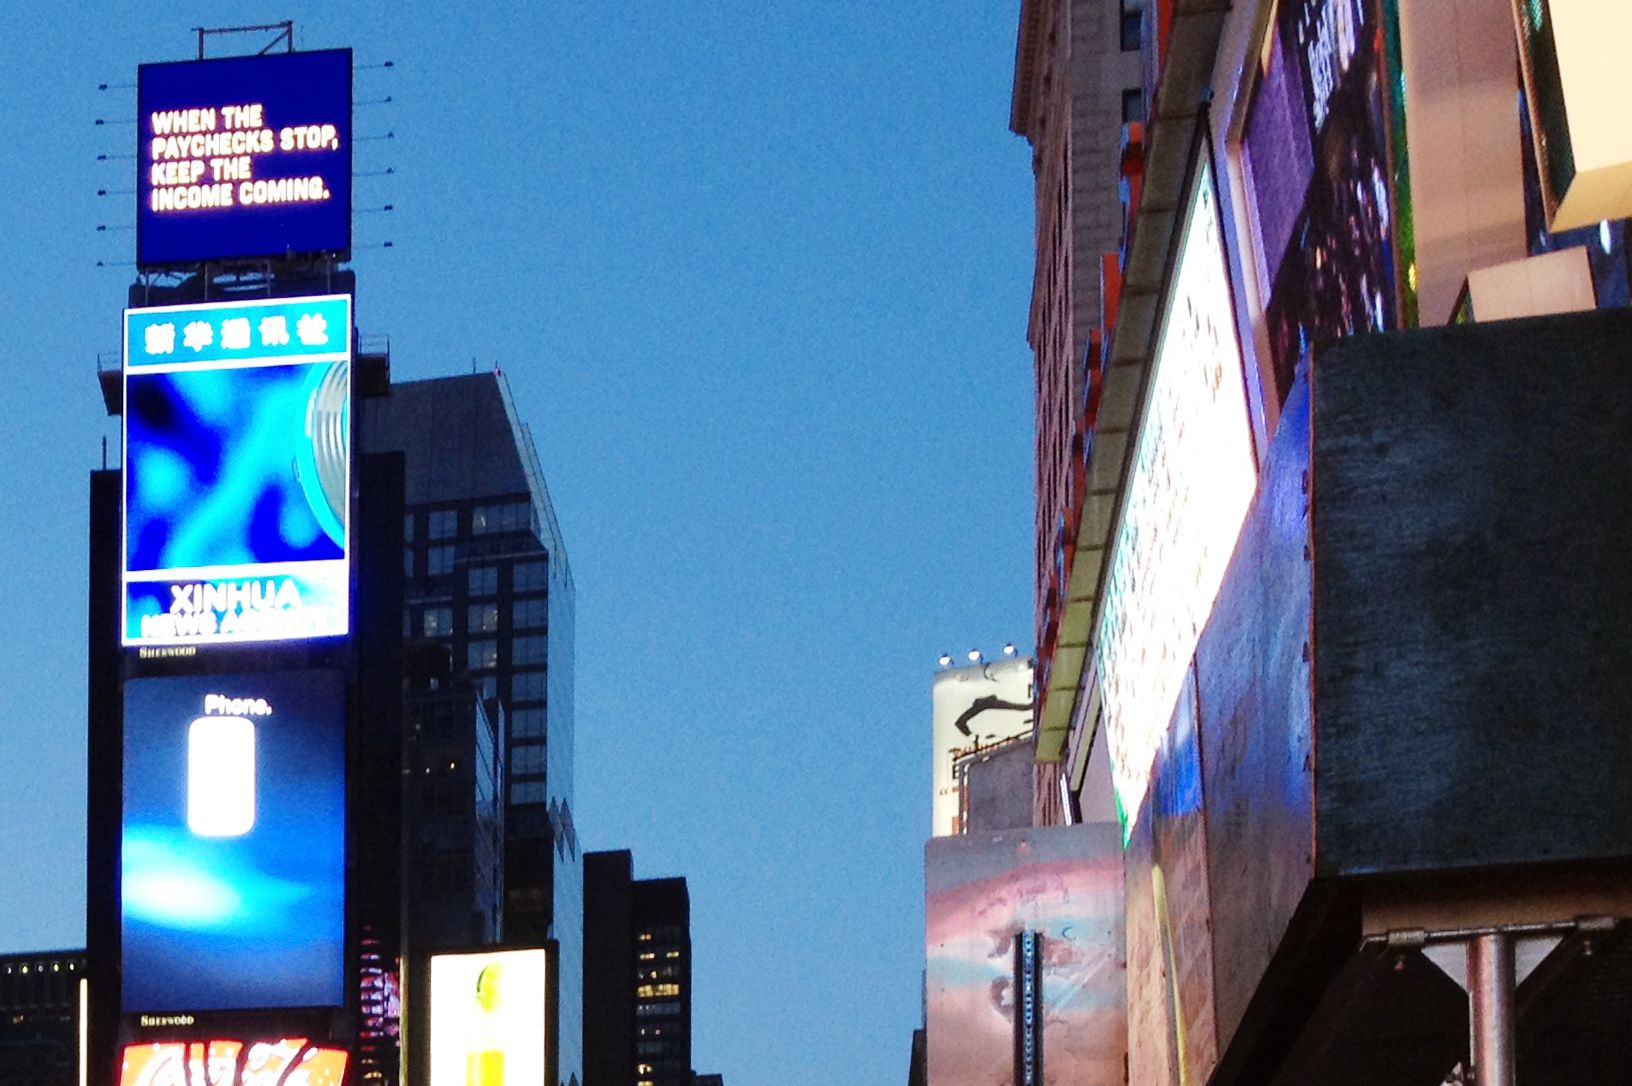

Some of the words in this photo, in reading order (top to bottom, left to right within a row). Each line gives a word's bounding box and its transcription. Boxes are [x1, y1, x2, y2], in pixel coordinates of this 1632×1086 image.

[152, 107, 216, 135] WHEN
[221, 103, 263, 130] THE
[152, 129, 274, 161] PAYCHECKS
[279, 124, 339, 151] STOP,
[152, 160, 206, 186] KEEP
[210, 156, 252, 181] THE
[152, 183, 234, 213] INCOME
[238, 176, 331, 205] COMING.
[169, 578, 303, 614] XINHUA
